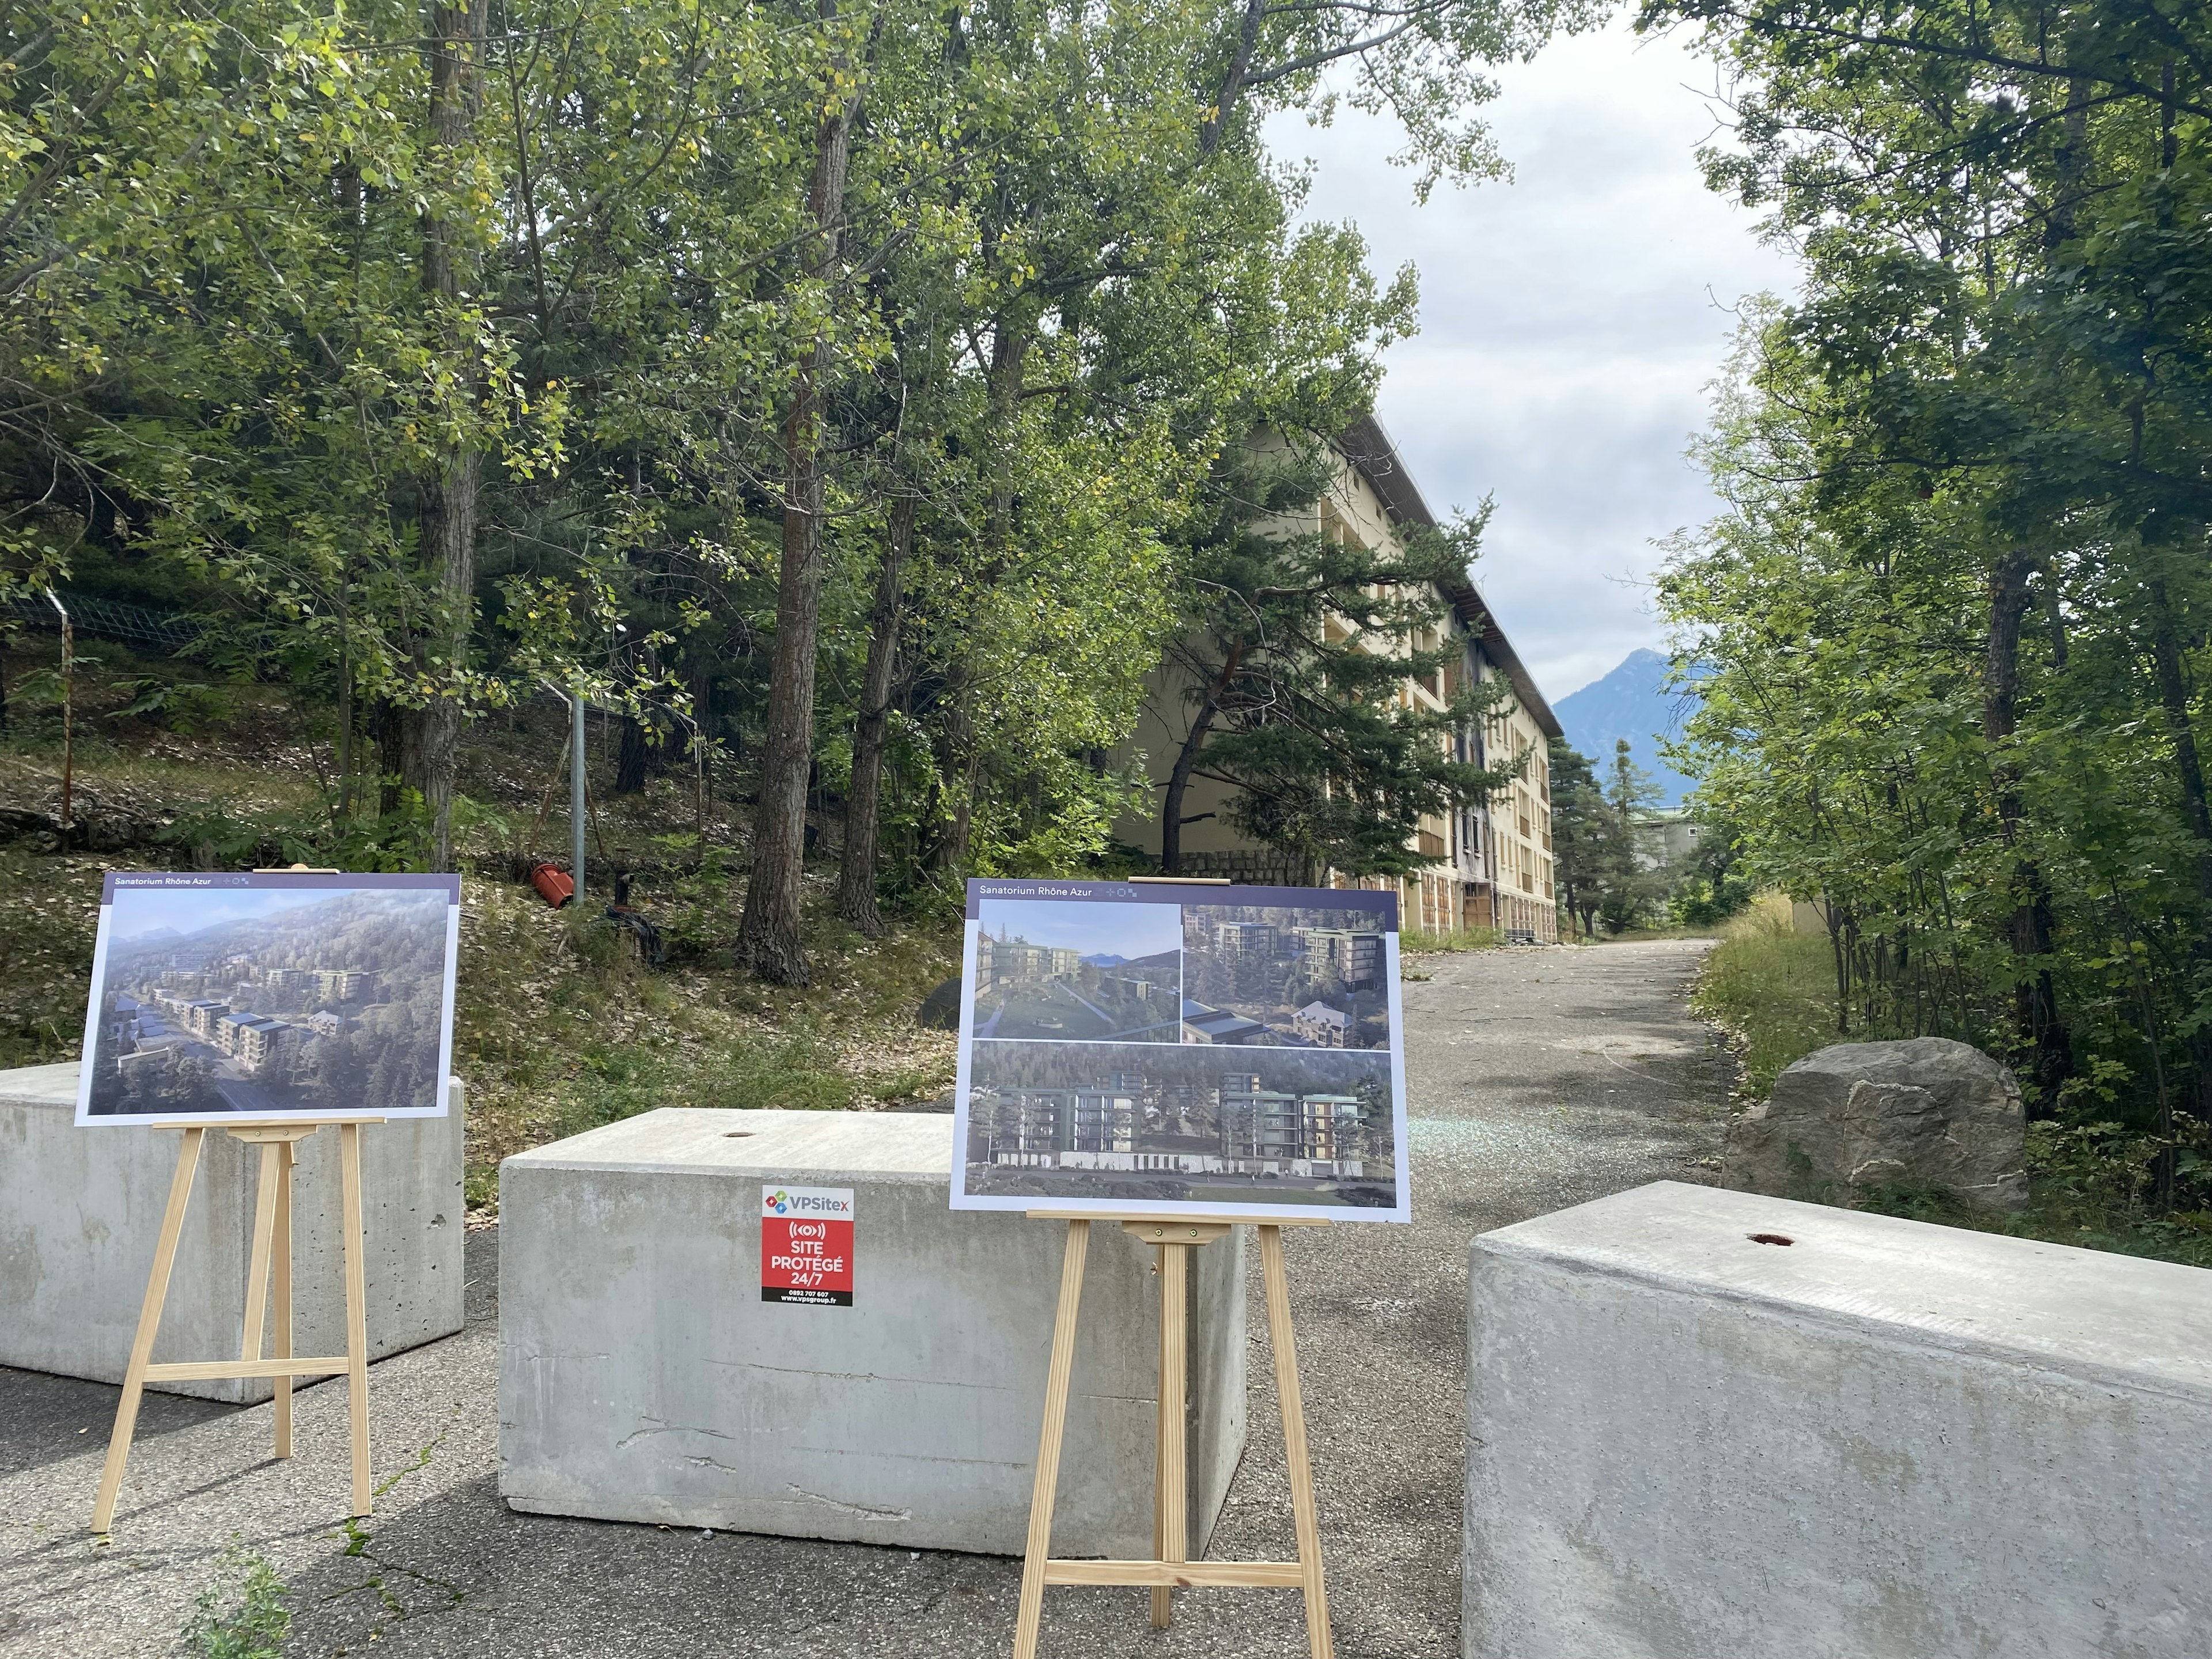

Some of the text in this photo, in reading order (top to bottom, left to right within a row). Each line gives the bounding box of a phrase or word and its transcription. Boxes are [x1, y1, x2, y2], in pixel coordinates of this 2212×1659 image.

[979, 885, 1092, 896] Sanatorium Rhône Azur
[790, 1196, 850, 1211] VPSitex
[791, 1240, 824, 1255] SITE
[771, 1255, 843, 1272] PROTÉGÉ
[791, 1272, 823, 1287] 24/7
[781, 1296, 837, 1304] www.vpsgroup.fr
